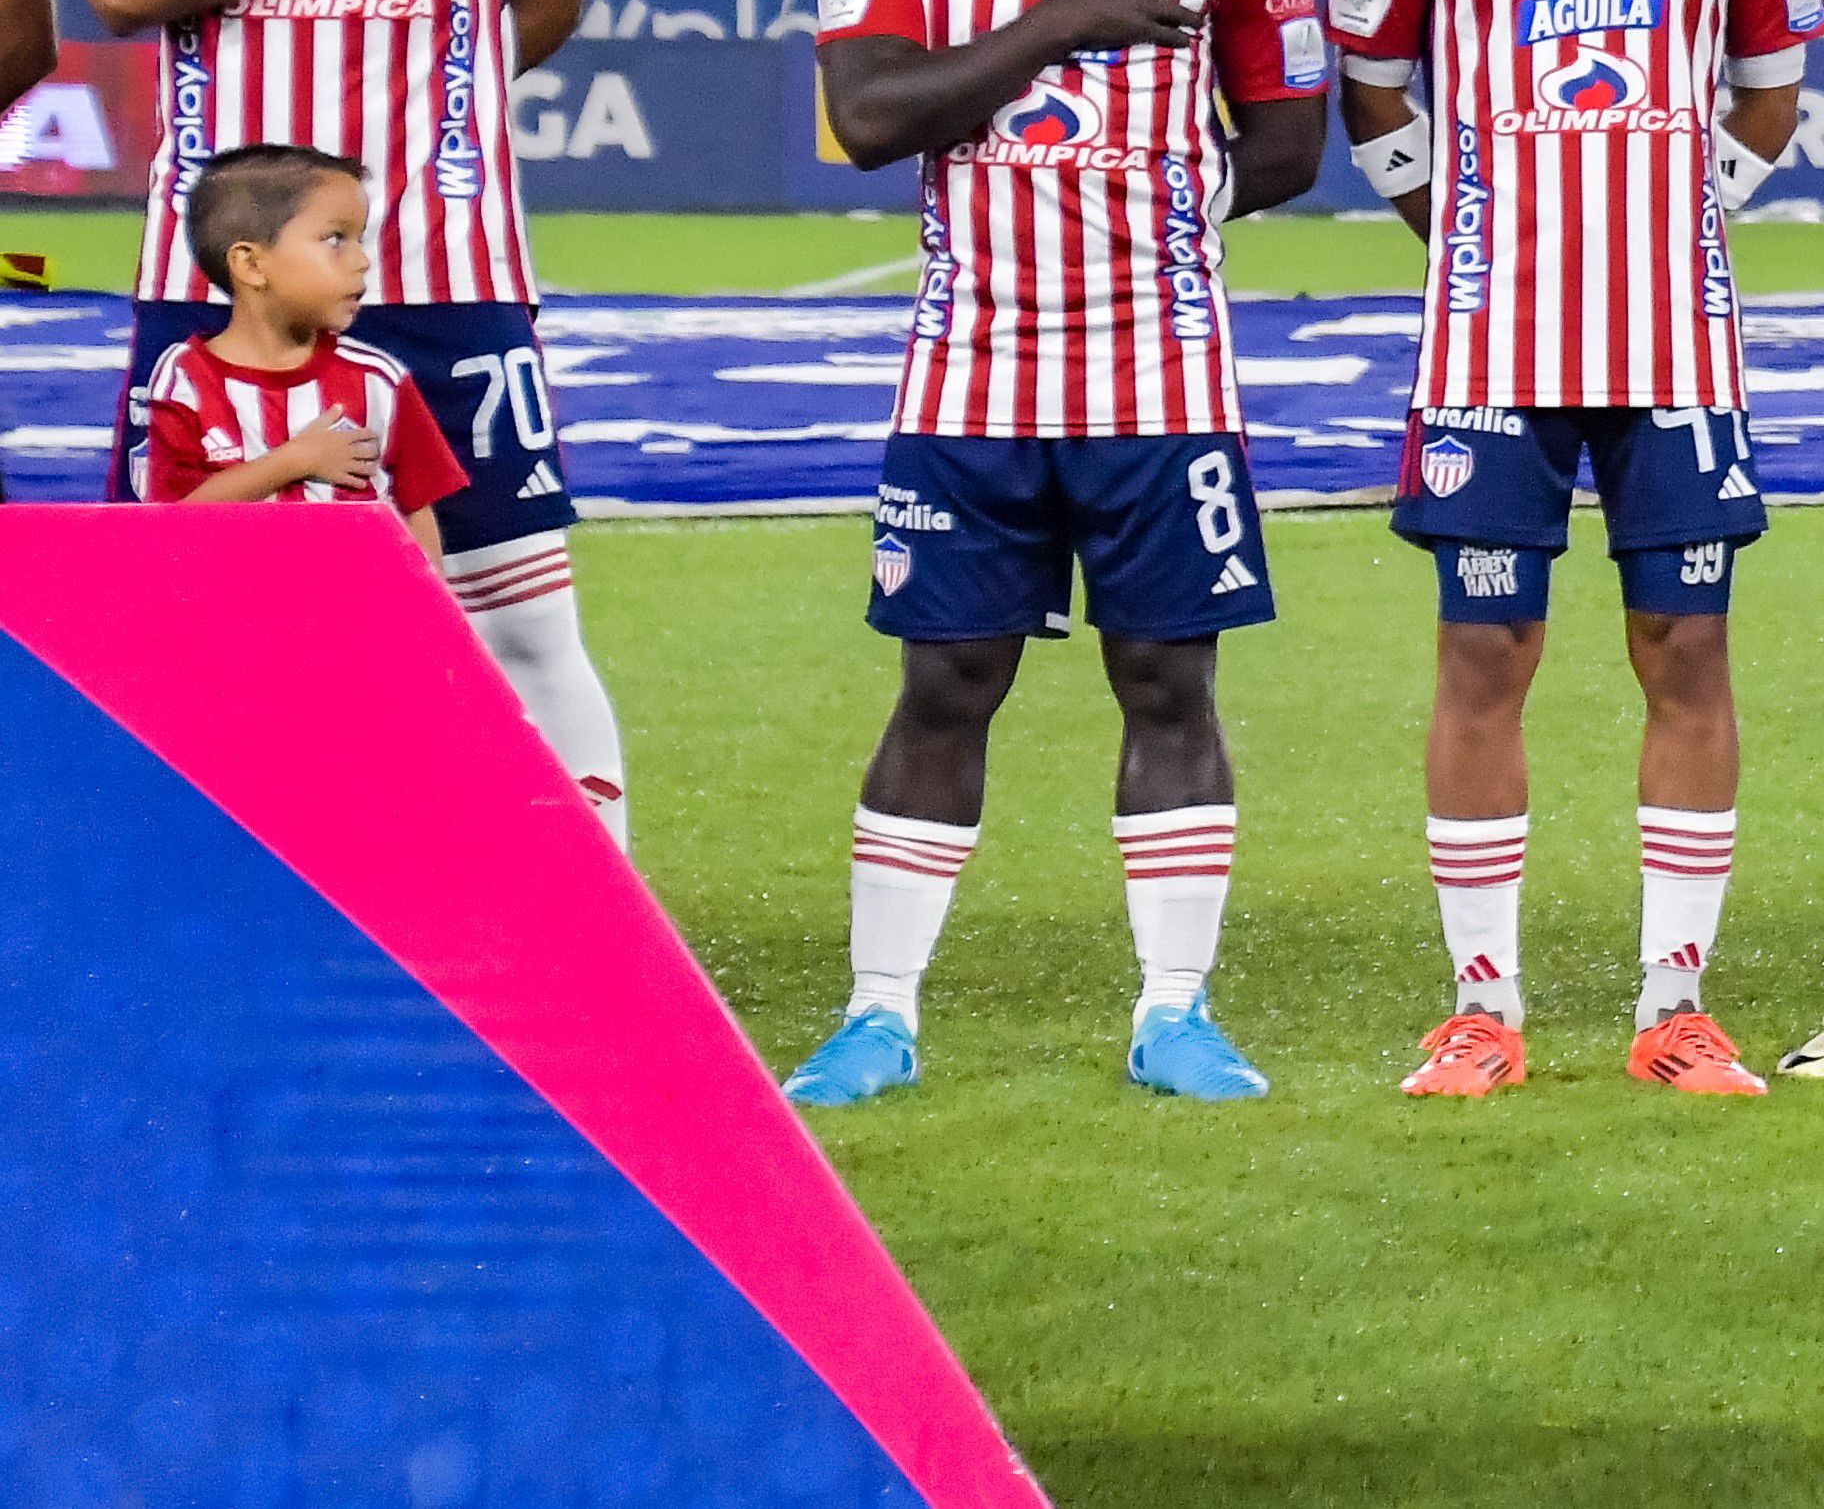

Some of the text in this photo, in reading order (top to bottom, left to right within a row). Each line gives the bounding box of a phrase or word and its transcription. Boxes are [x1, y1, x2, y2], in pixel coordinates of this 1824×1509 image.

[1493, 108, 1693, 135] OLIMPICA
[951, 140, 1149, 171] OLIMPICA
[452, 346, 553, 458] 70
[1188, 450, 1243, 553] 8
